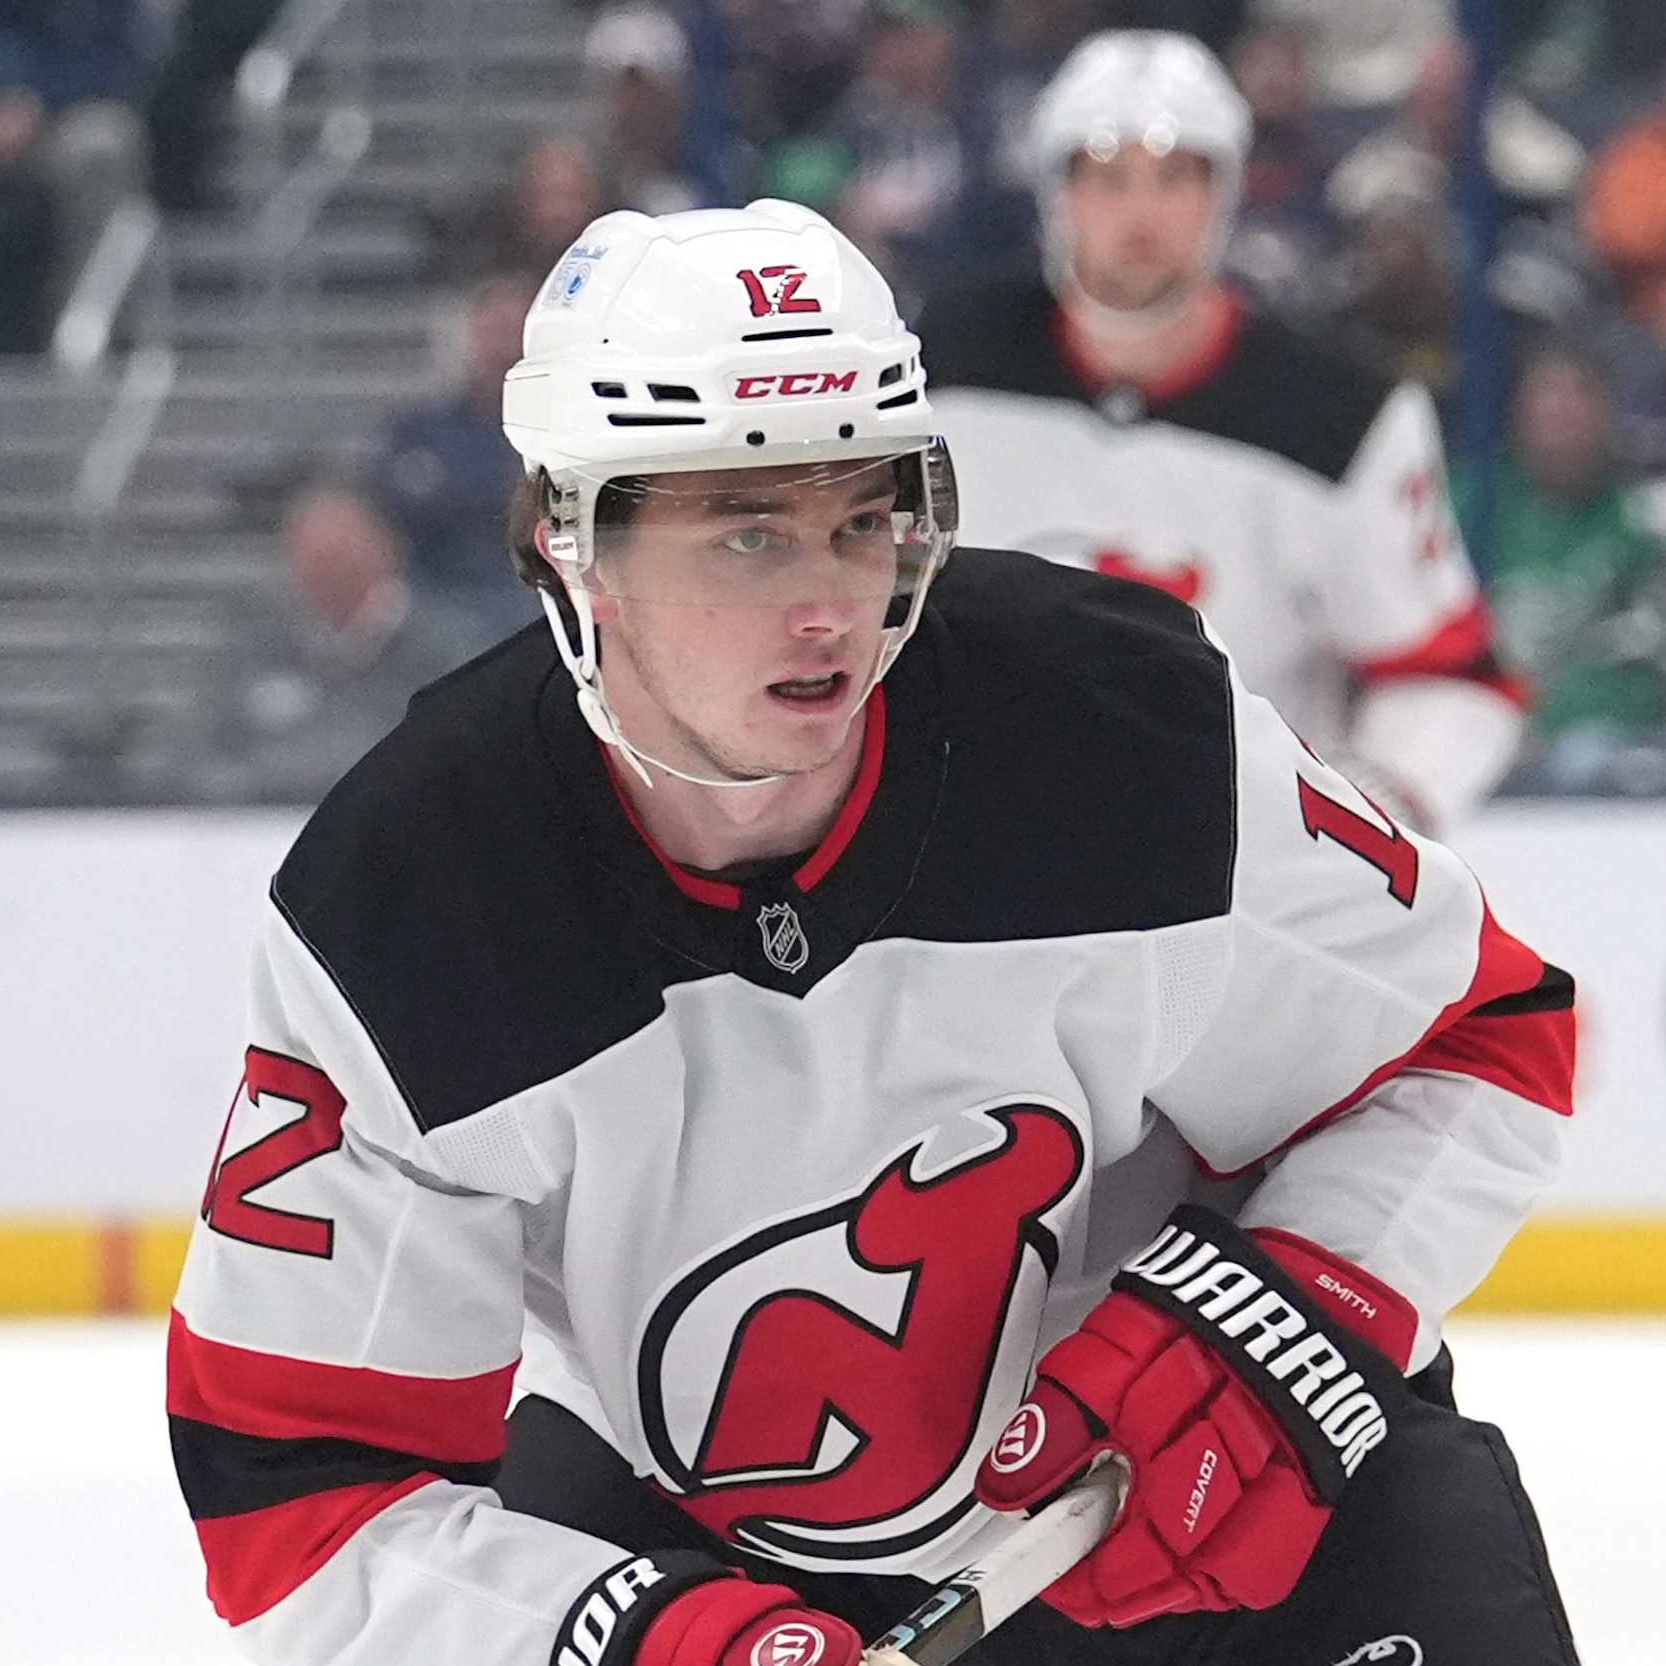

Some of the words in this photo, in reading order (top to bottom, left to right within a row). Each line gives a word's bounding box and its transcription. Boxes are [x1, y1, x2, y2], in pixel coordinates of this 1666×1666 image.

[736, 265, 822, 317] 12
[734, 371, 858, 399] CCM
[1295, 740, 1419, 911] 1
[201, 1044, 348, 1261] 2
[1315, 1273, 1377, 1319] SMITH
[1124, 1224, 1388, 1479] WARRIOR
[1183, 1449, 1218, 1533] COVERT
